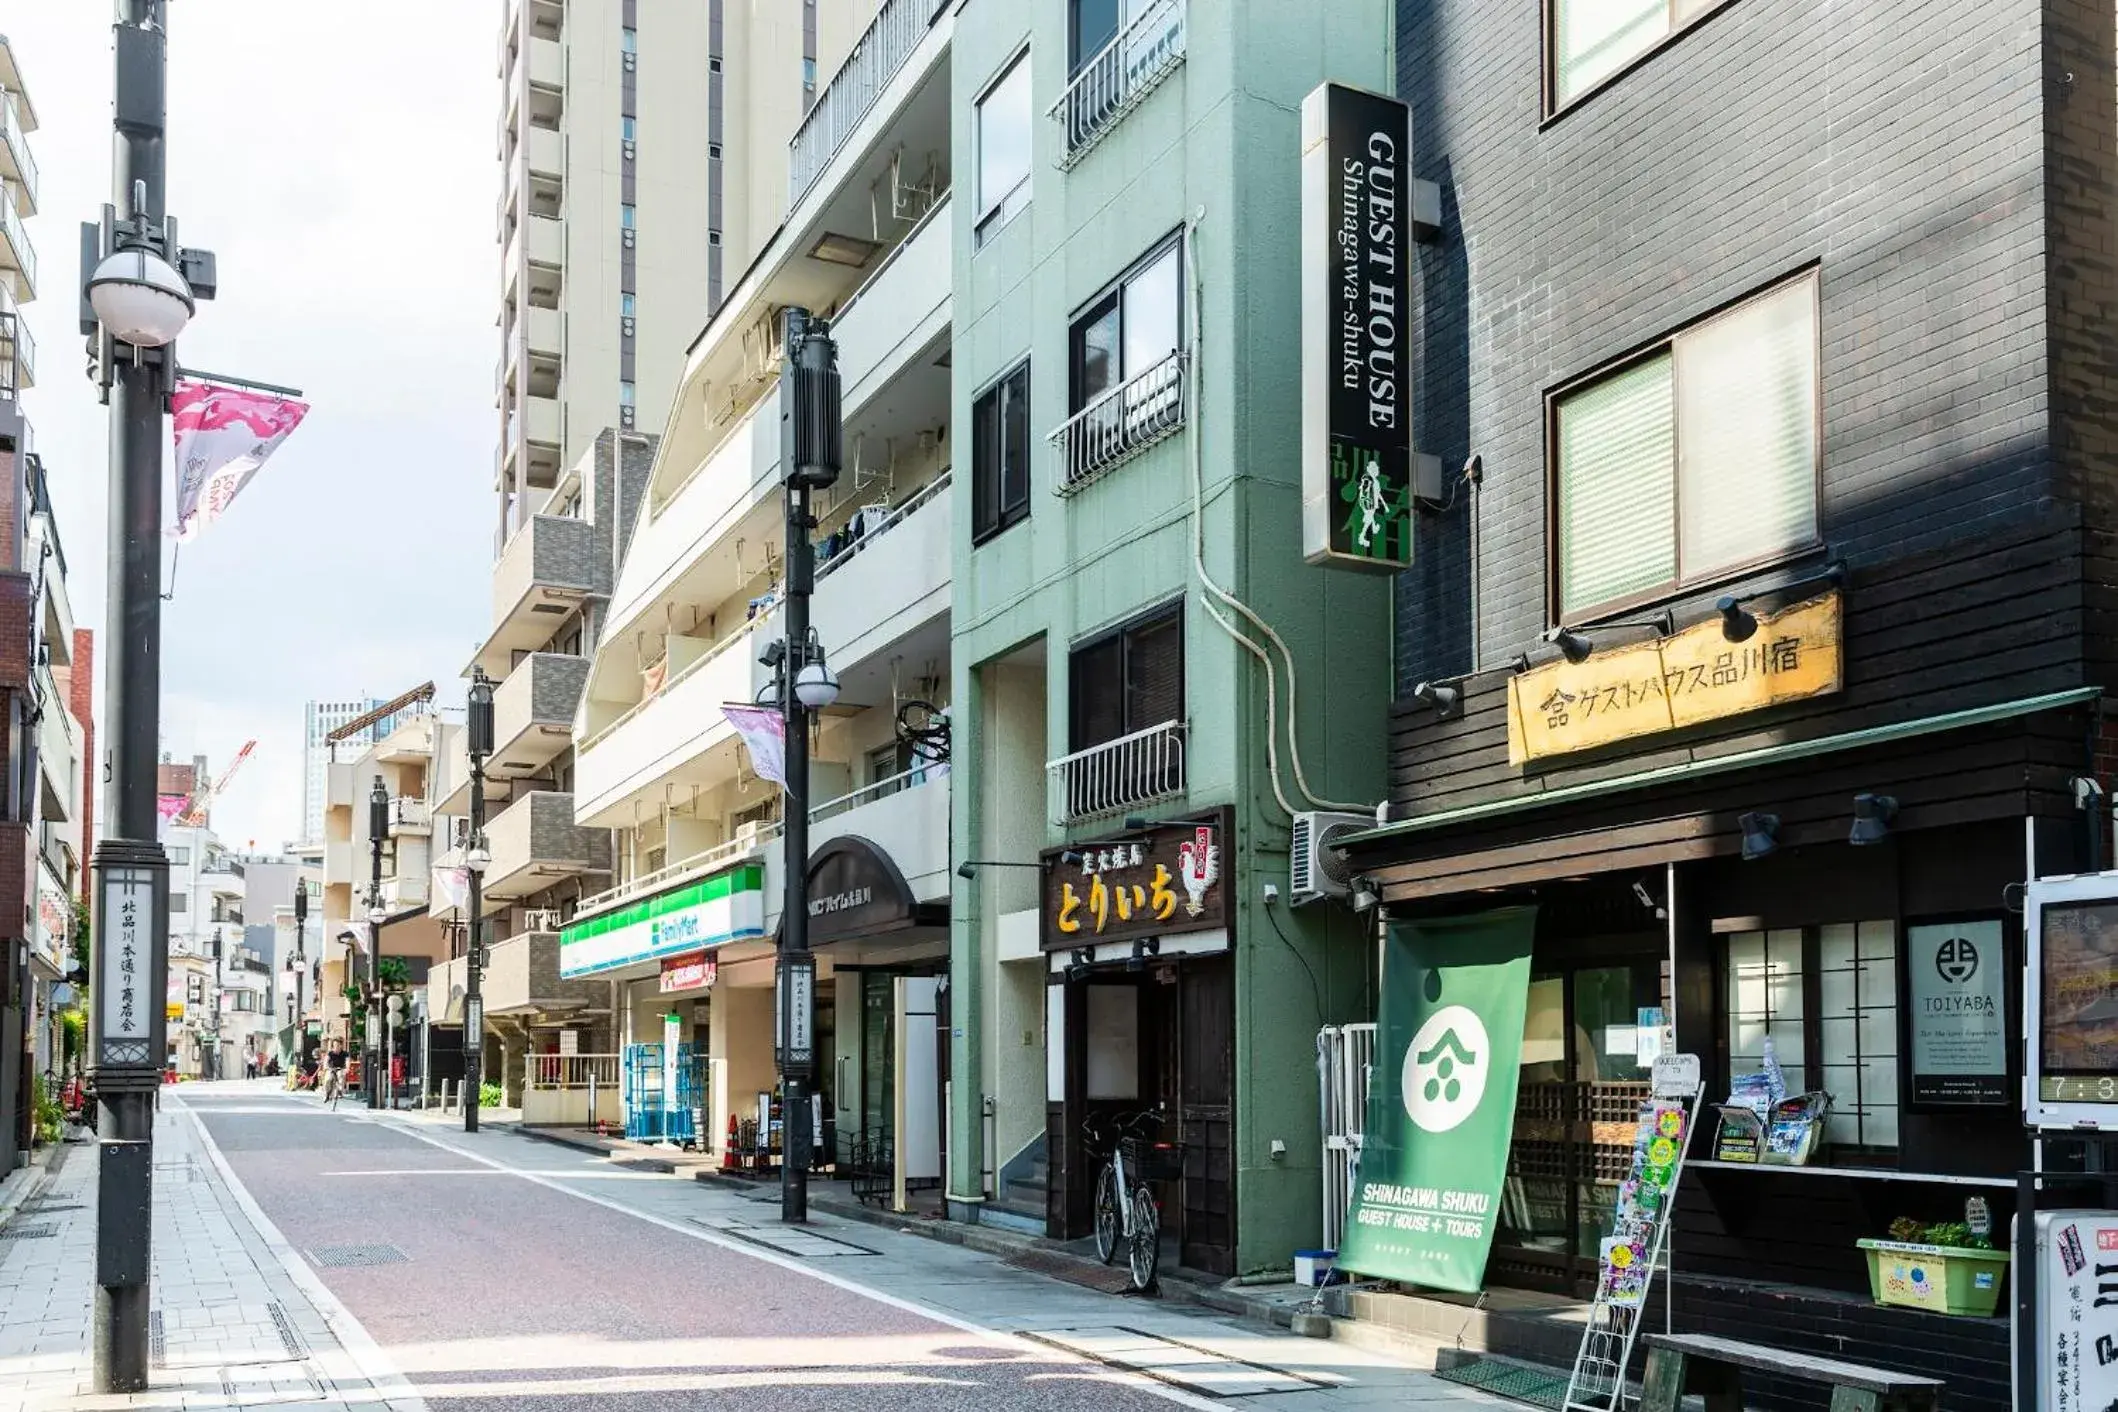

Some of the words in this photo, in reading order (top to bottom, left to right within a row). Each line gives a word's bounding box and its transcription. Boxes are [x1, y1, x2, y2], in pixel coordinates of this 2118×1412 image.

[1368, 131, 1396, 278] GUEST
[1339, 157, 1364, 389] Shinagawa-shuku
[1368, 282, 1396, 429] HOUSE
[660, 914, 699, 942] FamilyMart
[1058, 863, 1178, 934] とりいち
[120, 900, 137, 1032] 北品川本通り商店会
[1925, 995, 1994, 1011] TOIYABA
[1358, 1209, 1393, 1227] GUEST
[1393, 1213, 1430, 1232] HOUSE
[1447, 1219, 1483, 1239] TOURS
[1362, 1183, 1438, 1209] SHINAGAWA
[1441, 1191, 1490, 1213] SHUKU
